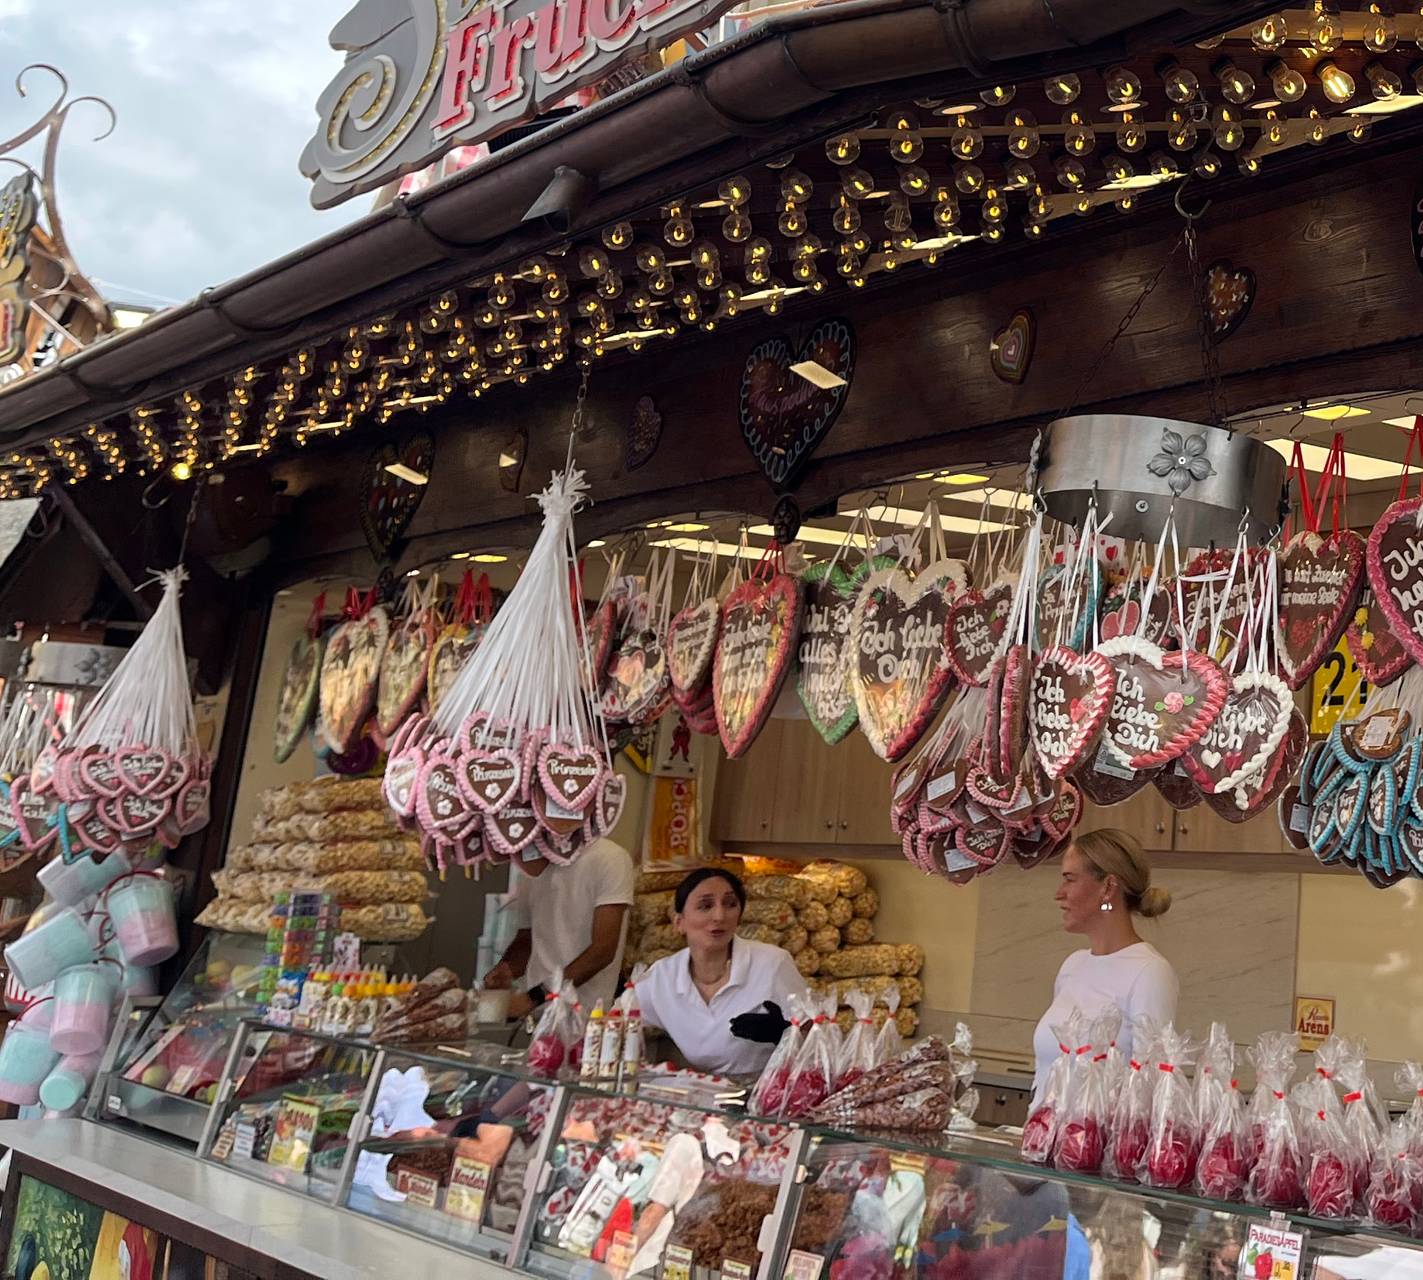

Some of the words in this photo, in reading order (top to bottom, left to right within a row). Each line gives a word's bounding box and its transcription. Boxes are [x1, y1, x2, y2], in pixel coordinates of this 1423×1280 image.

[431, 0, 672, 130] Fruc
[957, 608, 984, 632] Ich
[861, 618, 896, 655] Ich
[966, 636, 995, 660] Dich
[1037, 675, 1066, 703] Ich
[1115, 667, 1146, 702] Ich
[1040, 731, 1074, 758] Dich
[1114, 722, 1160, 753] Dich
[1298, 1017, 1329, 1036] Arens
